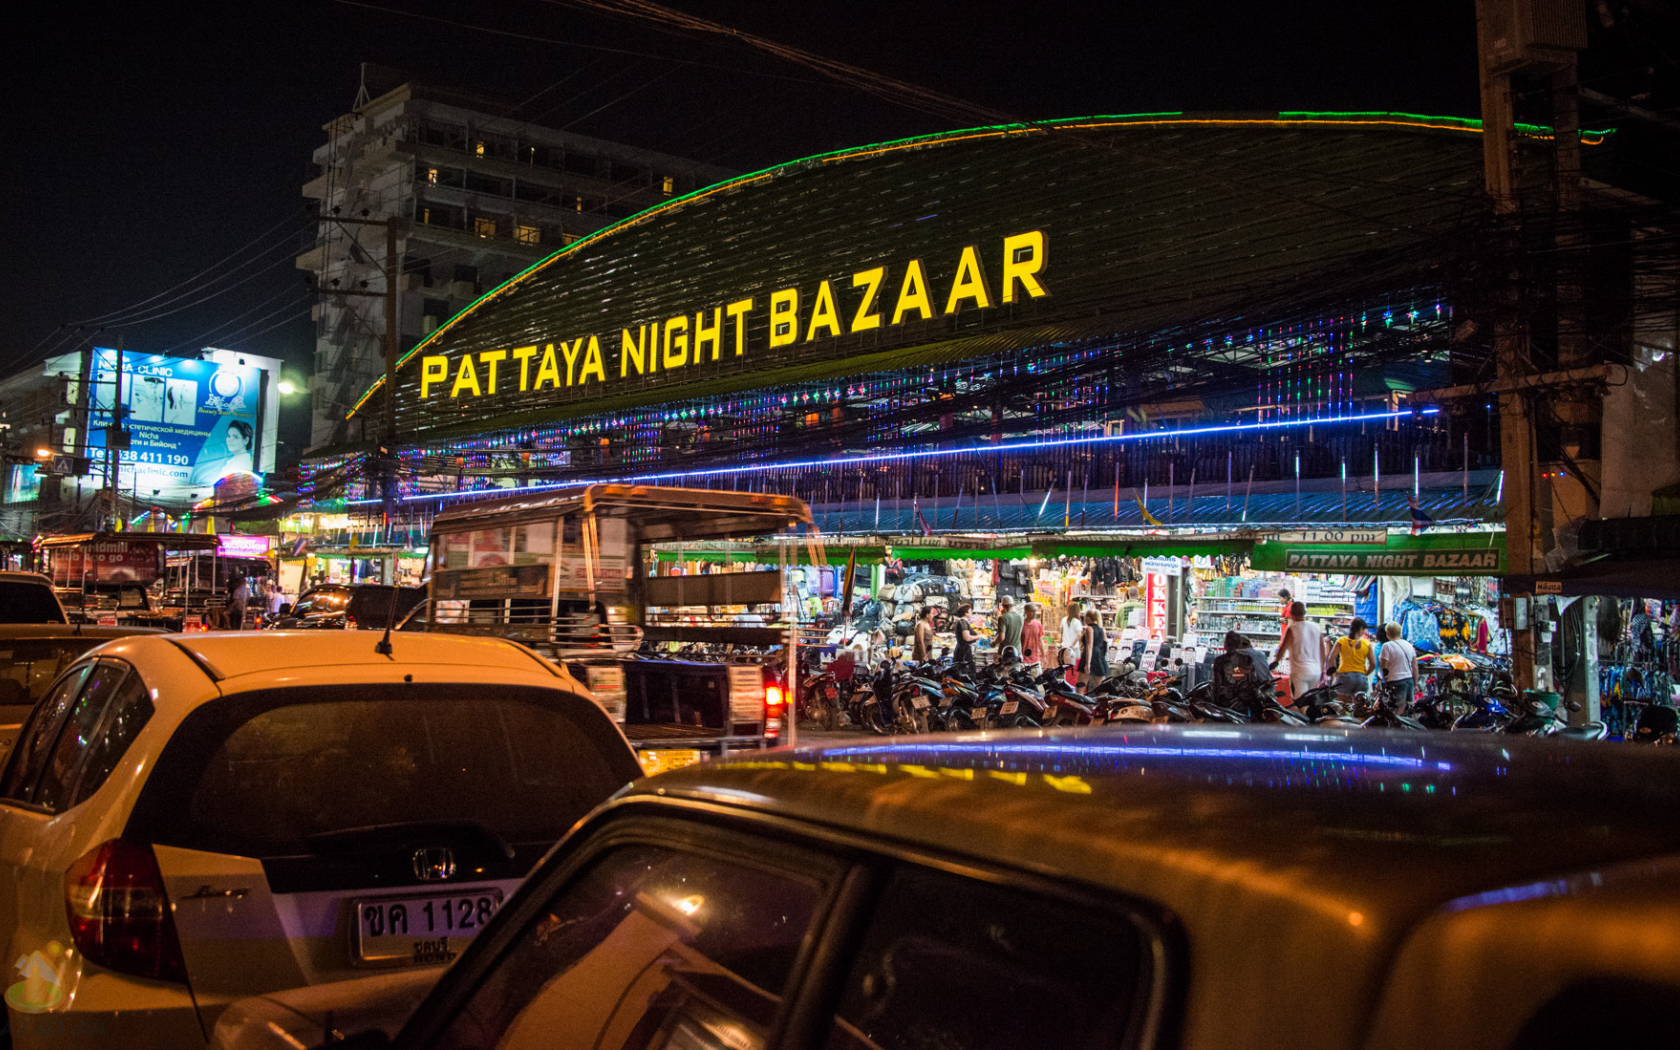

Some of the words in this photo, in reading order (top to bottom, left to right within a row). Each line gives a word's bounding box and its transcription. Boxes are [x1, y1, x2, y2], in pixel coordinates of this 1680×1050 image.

[420, 336, 606, 399] PATTAYA
[620, 298, 753, 378] NIGHT
[769, 230, 1046, 349] BAZAAR
[98, 359, 133, 373] NICA
[137, 364, 173, 377] CLINIC
[138, 431, 159, 440] Nicha
[140, 451, 163, 463] 411
[167, 454, 189, 466] 190
[1301, 530, 1345, 543] 11.00
[1350, 532, 1377, 545] pm
[1288, 553, 1359, 568] PATTAYA
[1364, 554, 1418, 568] NIGHT
[1423, 553, 1497, 567] BAZAAR
[422, 897, 492, 932] 1128
